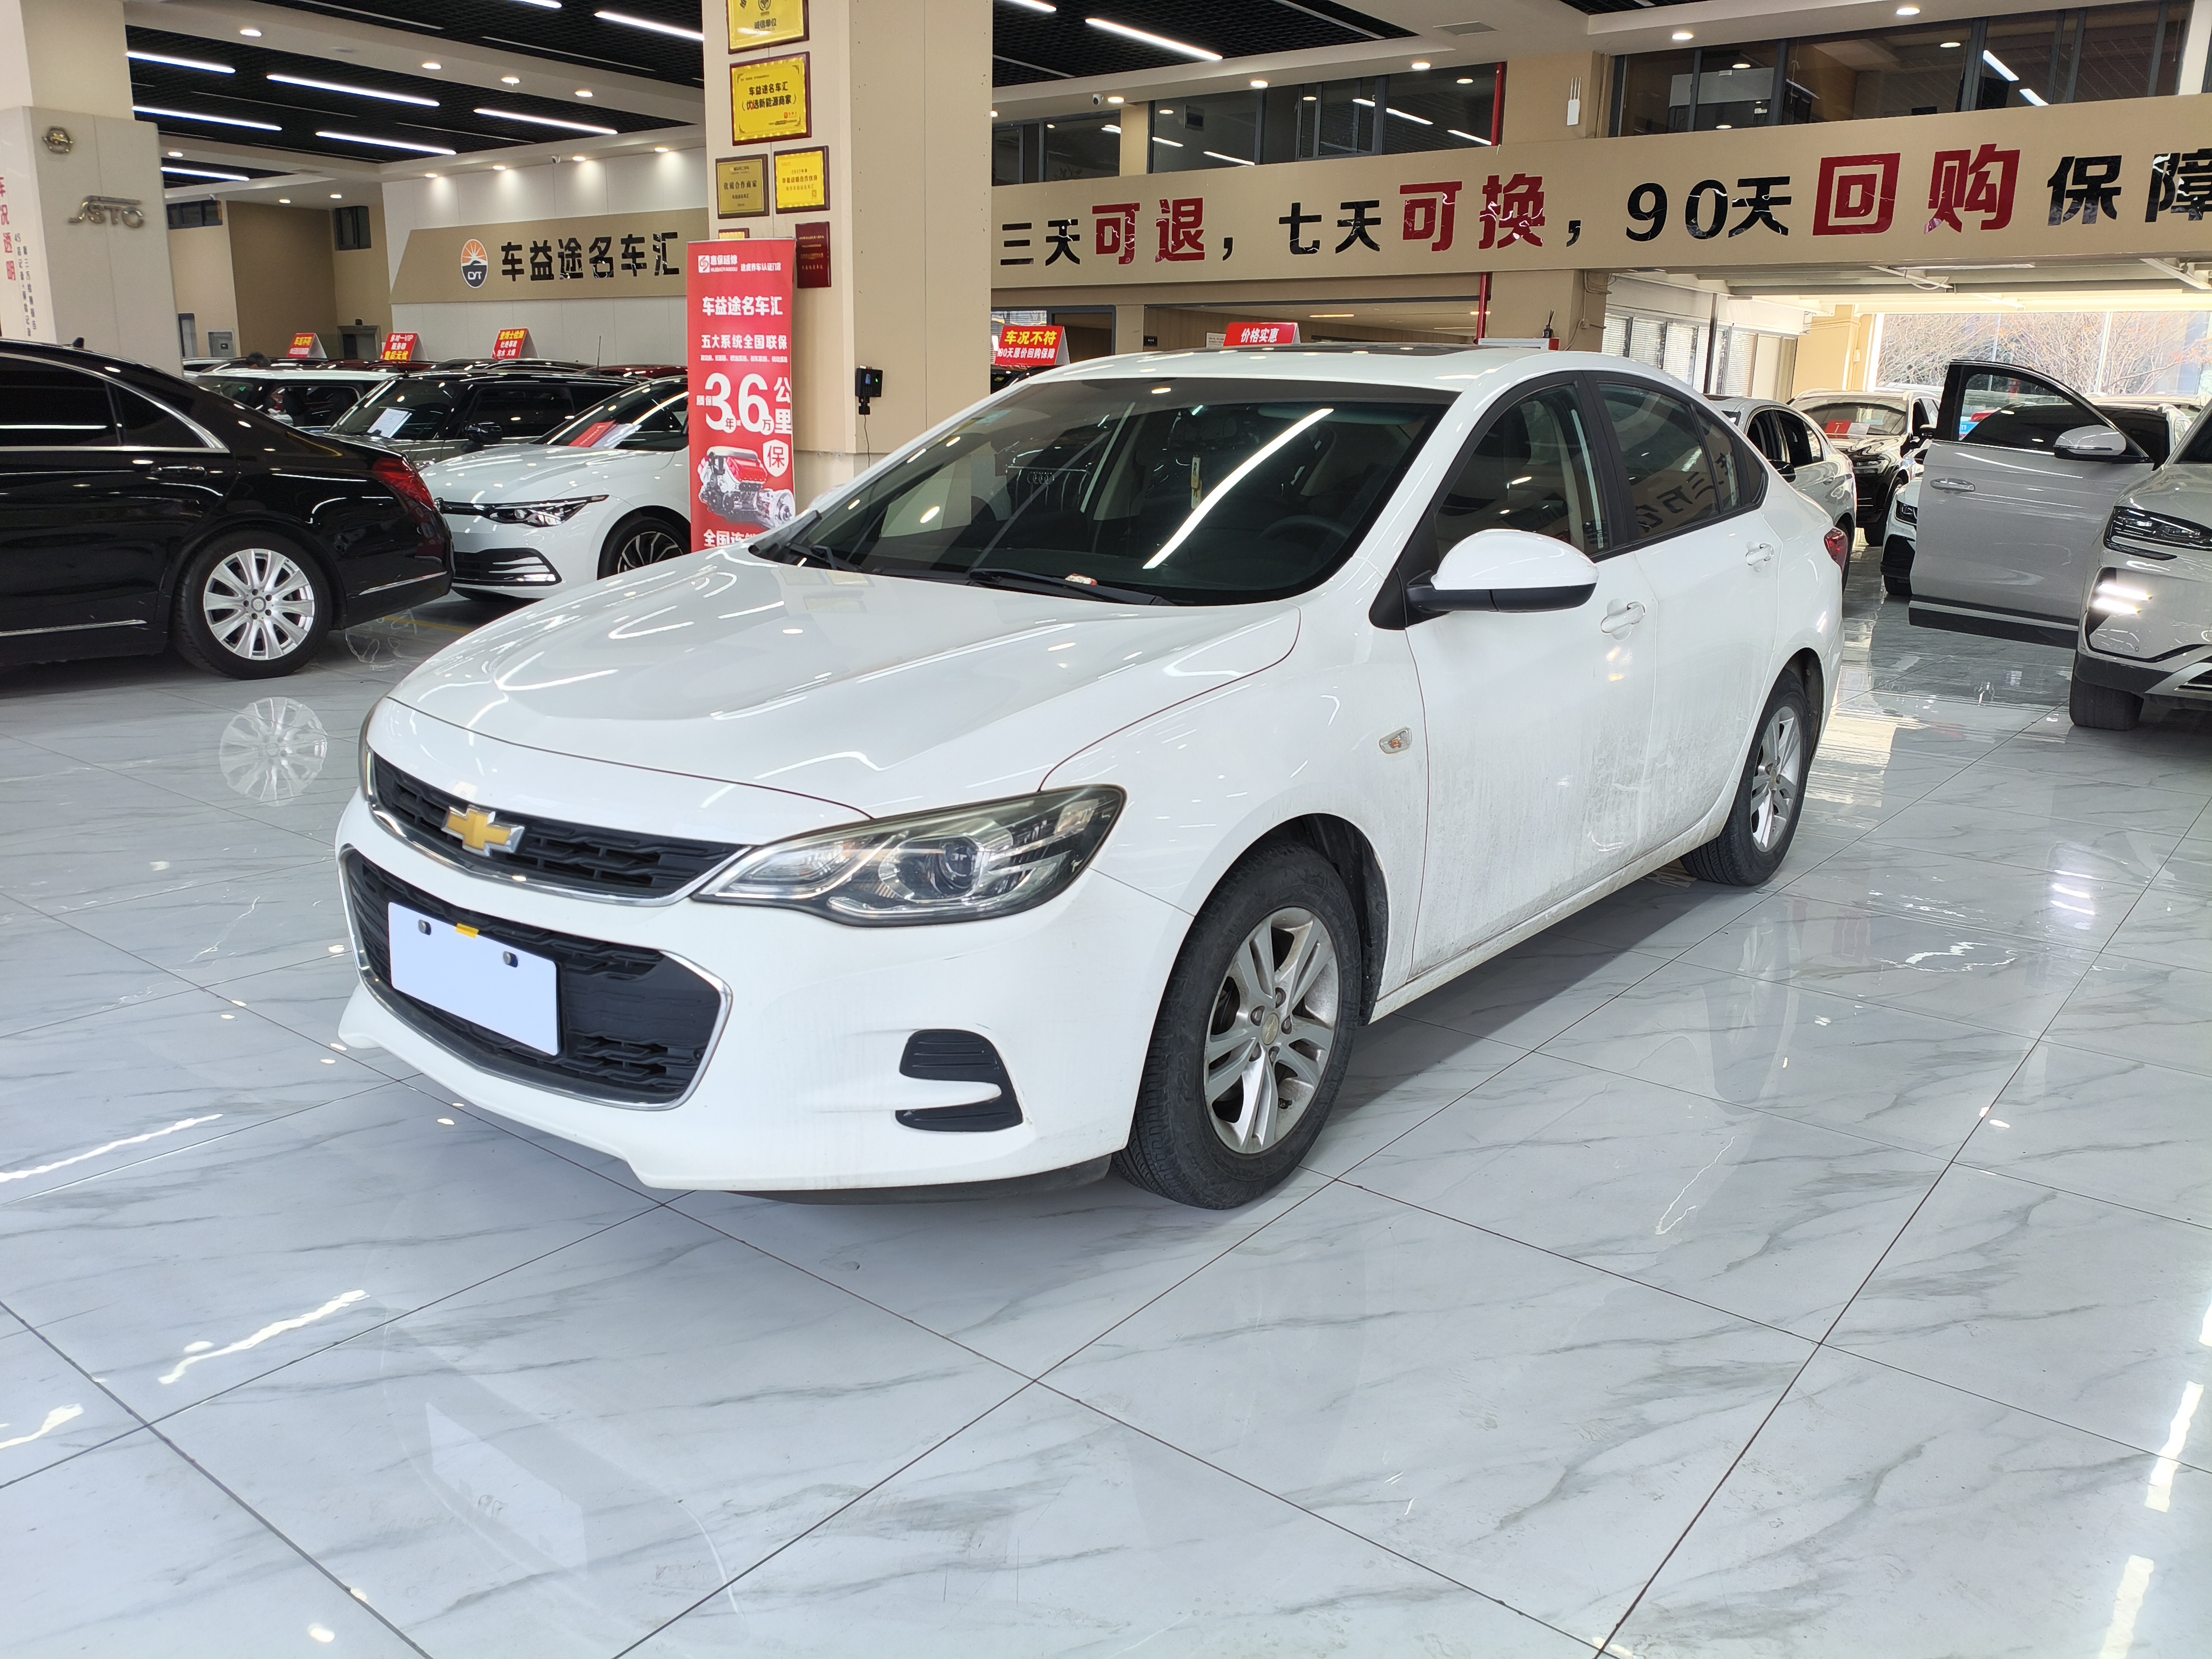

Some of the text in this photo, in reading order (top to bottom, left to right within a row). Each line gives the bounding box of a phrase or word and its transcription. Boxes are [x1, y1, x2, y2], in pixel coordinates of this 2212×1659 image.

[501, 232, 680, 282] 车益途名车汇
[702, 296, 783, 316] 车益途名车汇
[701, 334, 787, 350] 五大系统全国联保
[1004, 330, 1057, 346] 车况不符
[1240, 328, 1279, 343] 价格实惠
[767, 446, 785, 468] 保
